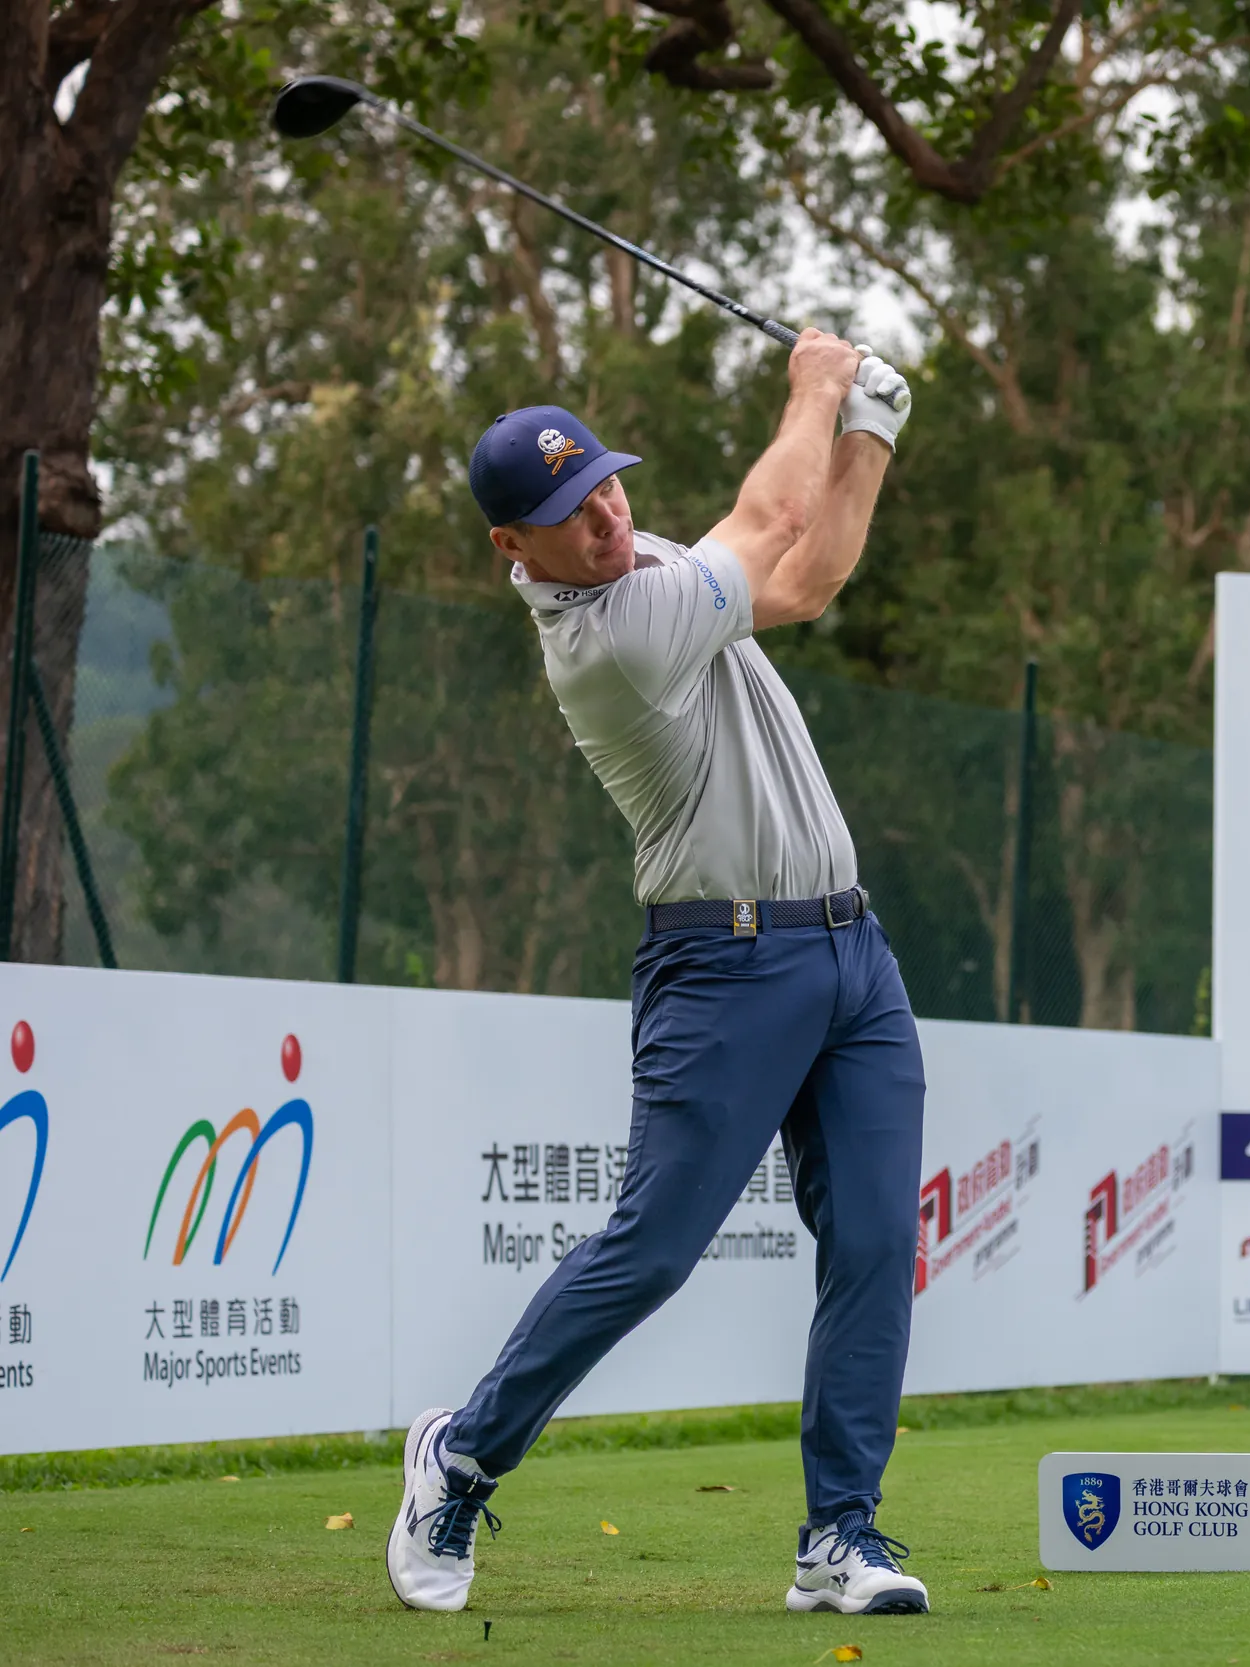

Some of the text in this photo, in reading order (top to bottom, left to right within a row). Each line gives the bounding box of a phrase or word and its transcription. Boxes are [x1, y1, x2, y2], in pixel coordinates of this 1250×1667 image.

[581, 588, 605, 597] HSBC
[483, 1221, 544, 1272] Major
[702, 1221, 795, 1259] ommittee
[145, 1297, 300, 1340] 大型體育活動
[143, 1346, 302, 1389] Major Sports Events
[1079, 1477, 1104, 1489] 1889
[1132, 1478, 1250, 1498] 香港哥爾夫球會
[1133, 1501, 1250, 1518] HONG KONG
[1133, 1521, 1239, 1538] GOLF CLUB
